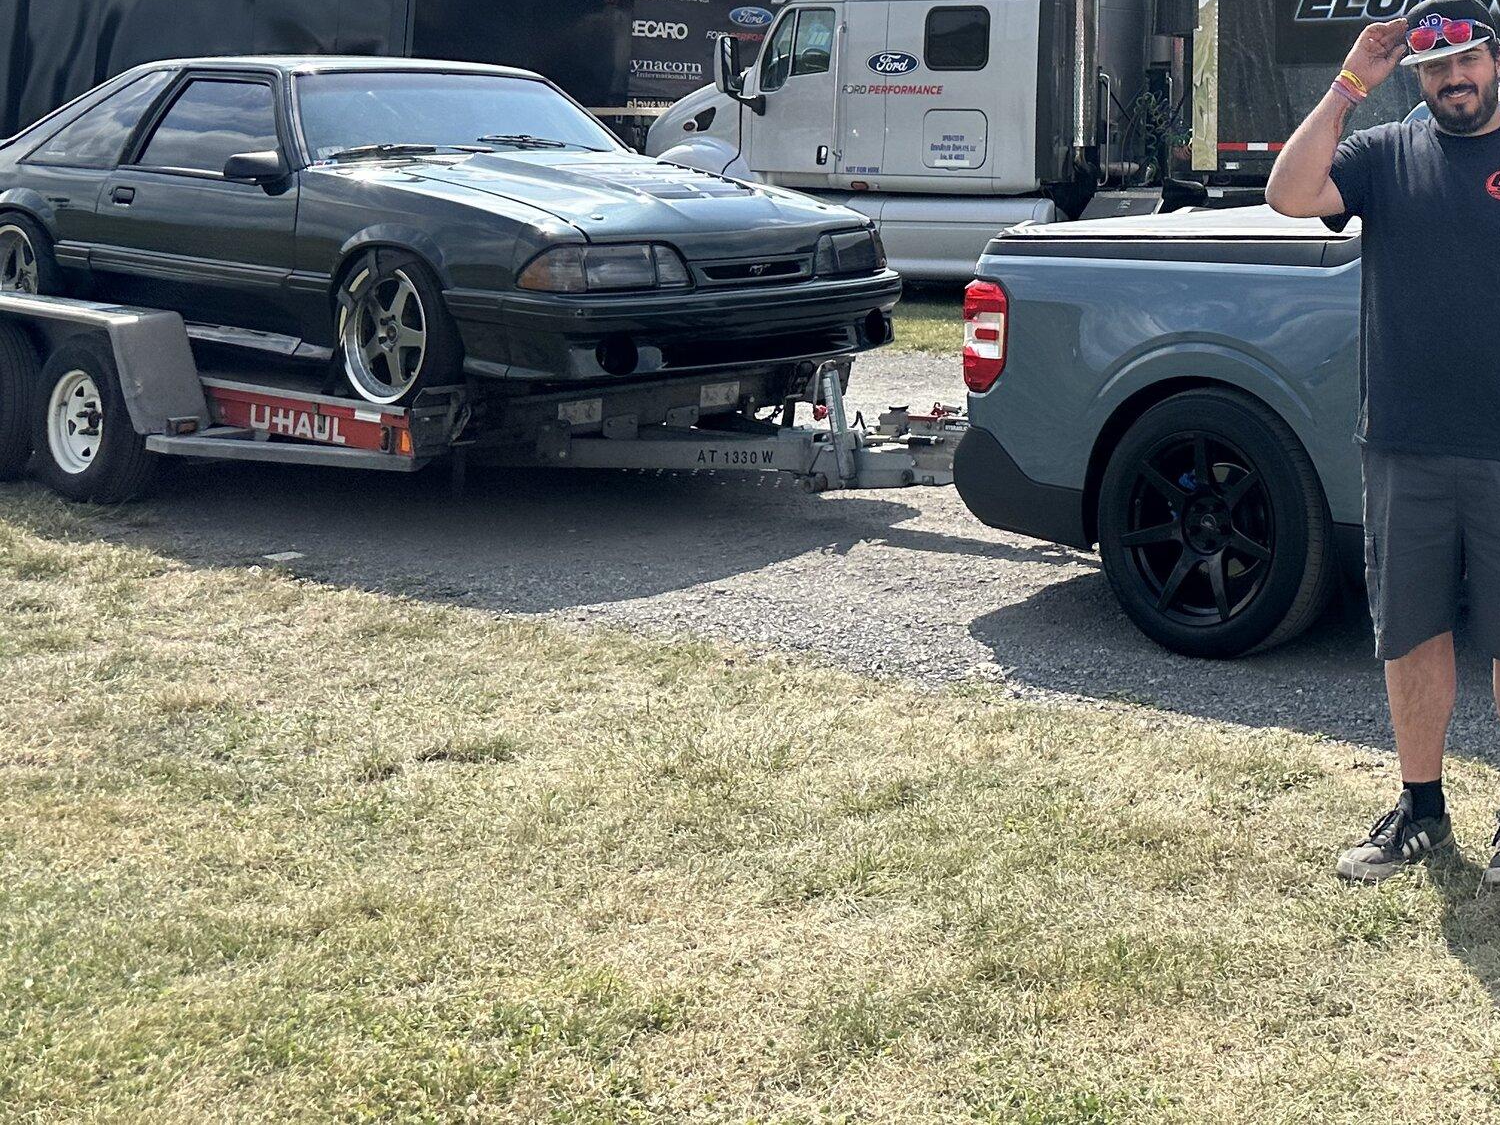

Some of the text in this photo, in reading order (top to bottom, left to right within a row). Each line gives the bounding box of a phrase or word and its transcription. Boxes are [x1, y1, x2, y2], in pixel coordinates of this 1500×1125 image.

[738, 9, 765, 24] Ford
[876, 54, 908, 72] Ford
[636, 71, 686, 80] International
[841, 84, 944, 95] FORD PERFORMANCE
[724, 451, 757, 464] 1330
[762, 451, 773, 463] W
